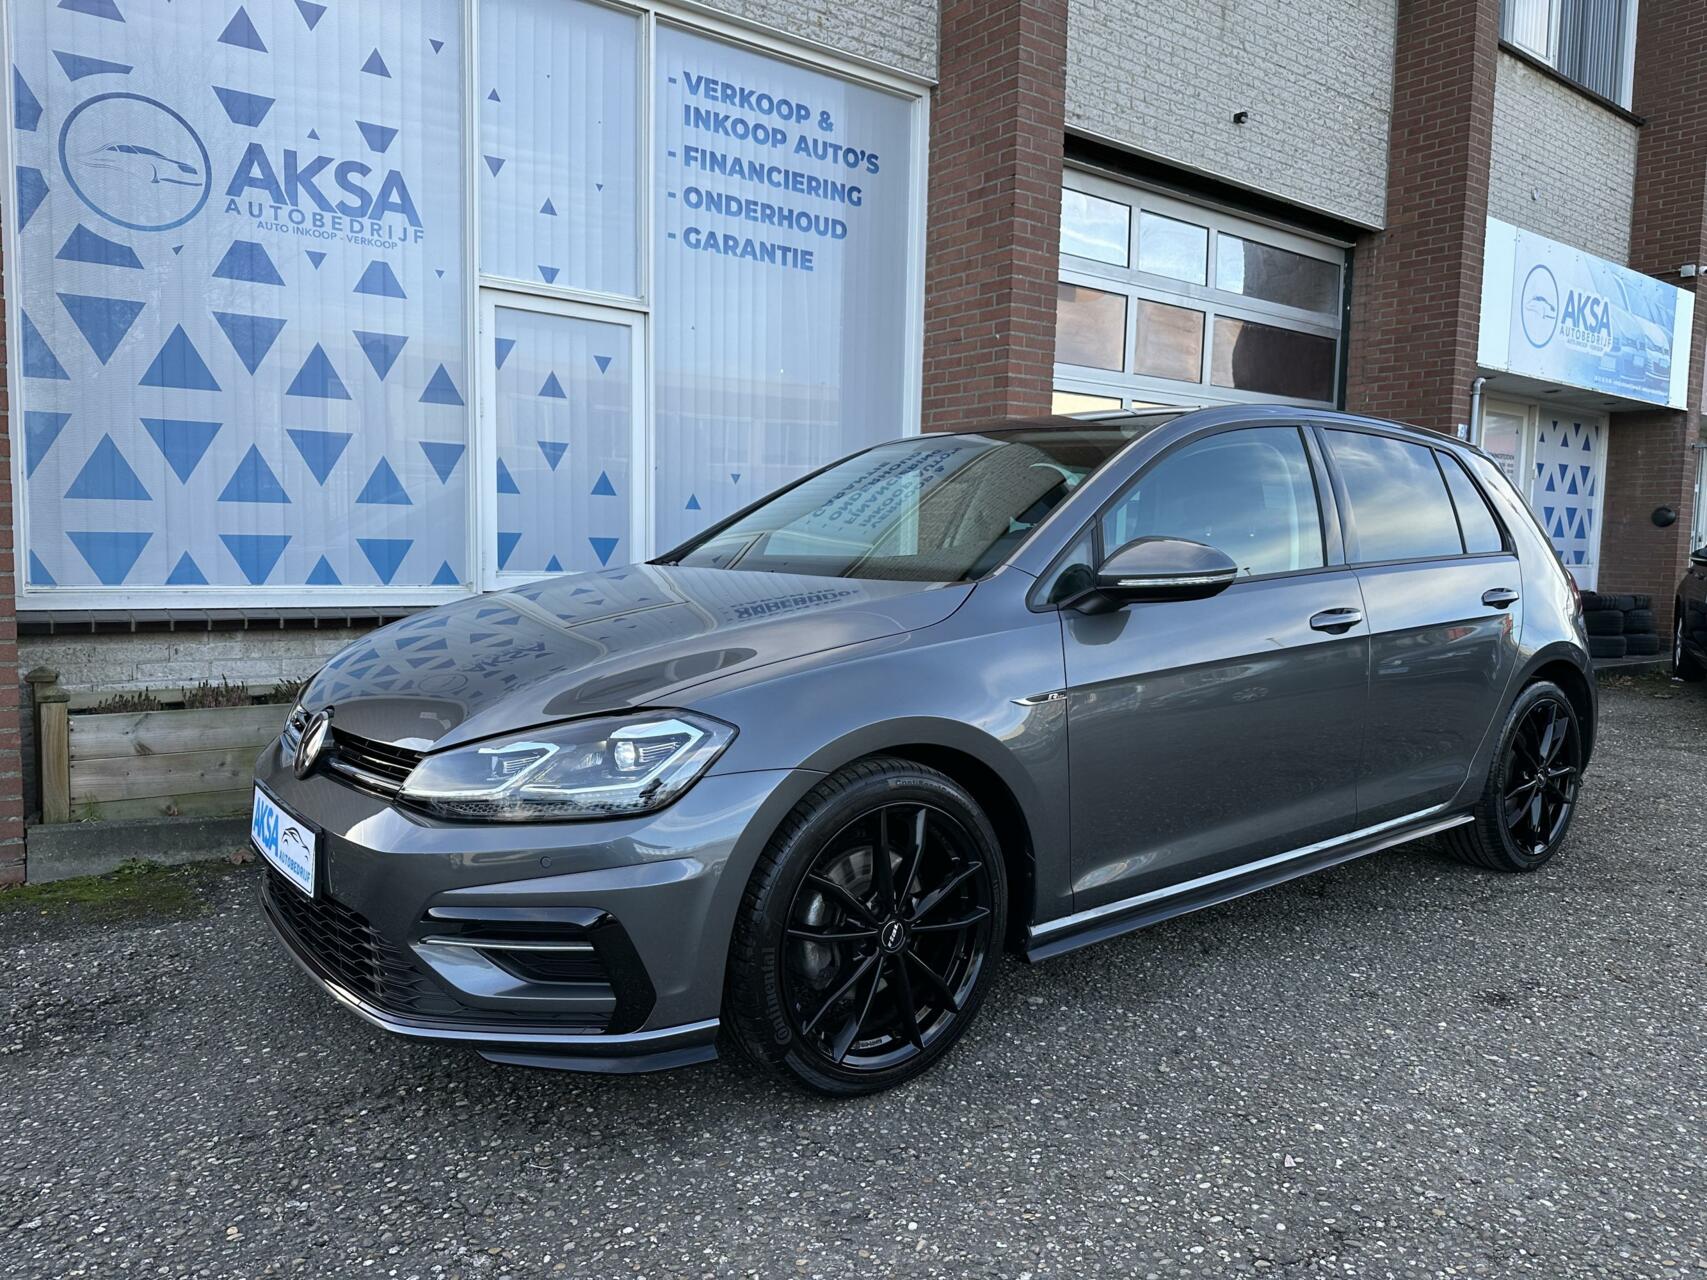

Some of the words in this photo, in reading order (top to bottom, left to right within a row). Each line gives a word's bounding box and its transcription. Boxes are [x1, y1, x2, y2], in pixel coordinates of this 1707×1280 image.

[683, 71, 811, 124] VERKOOP
[818, 110, 834, 132] &
[684, 104, 787, 148] INKOOP
[794, 135, 880, 174] AUTO'S
[225, 142, 423, 228] AKSA
[684, 144, 862, 207] FINANCIERING
[224, 198, 424, 244] AUTOBEDRIJF
[257, 221, 289, 233] AUTO
[293, 226, 337, 241] INKOOP
[346, 234, 397, 250] VERKOOP
[683, 186, 848, 240] ONDERHOUD
[683, 226, 814, 272] GARANTIE
[1559, 324, 1612, 348] AUTOBEDRIJF
[1561, 289, 1611, 337] AKSA
[253, 797, 279, 857] AKSA
[279, 850, 311, 883] AUTOBEDRIJF
[760, 947, 793, 1045] Continental
